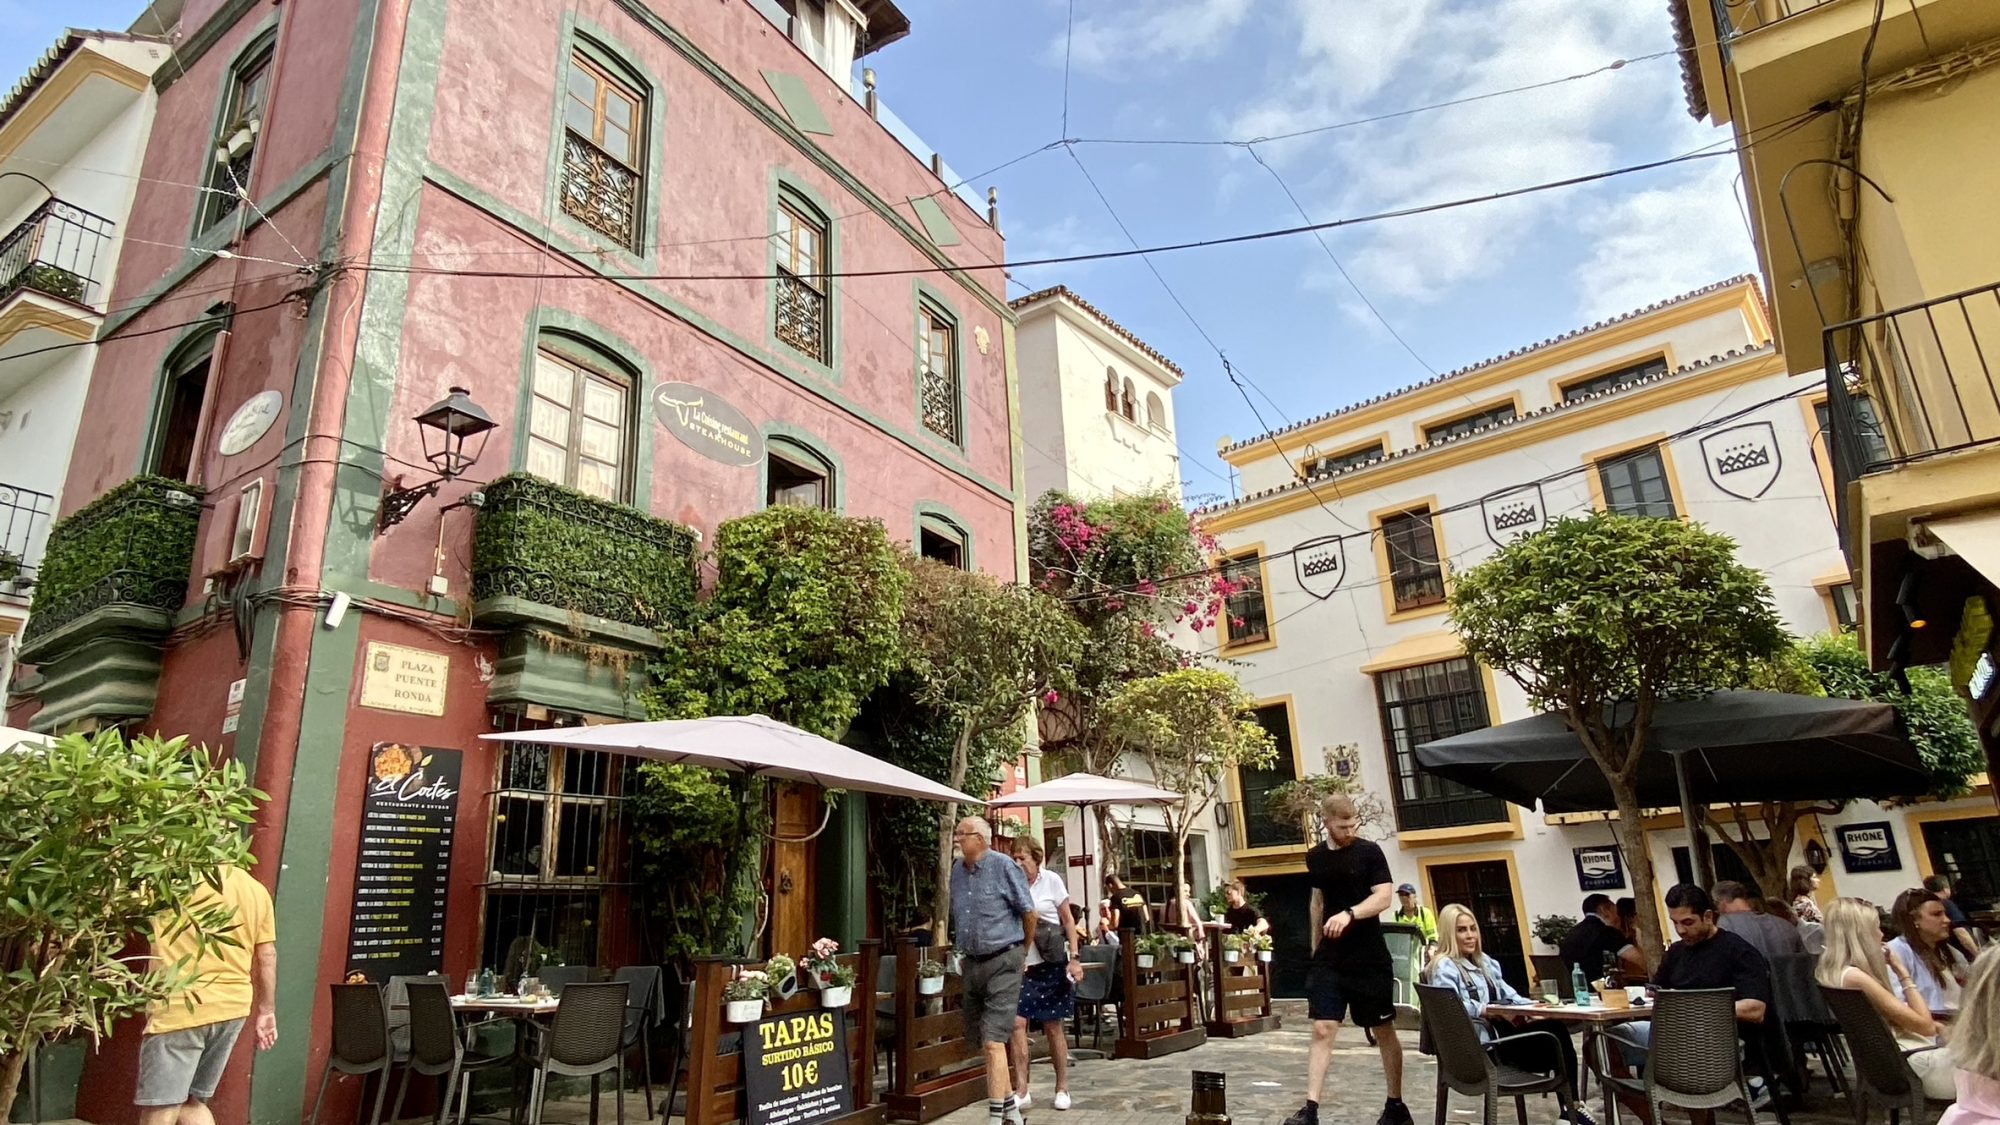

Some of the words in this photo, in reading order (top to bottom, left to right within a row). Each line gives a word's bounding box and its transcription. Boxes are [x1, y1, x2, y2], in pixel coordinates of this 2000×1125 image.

[689, 421, 752, 458] STEAKHOUSE
[401, 660, 435, 674] PLAZA
[395, 673, 438, 688] PUENTE
[394, 688, 433, 703] RONDA
[1847, 831, 1884, 843] RHONE
[1582, 854, 1612, 864] RHONE
[759, 1012, 834, 1050] TAPAS
[762, 1047, 801, 1066] SURTIDO
[802, 1041, 835, 1057] BÁSICO
